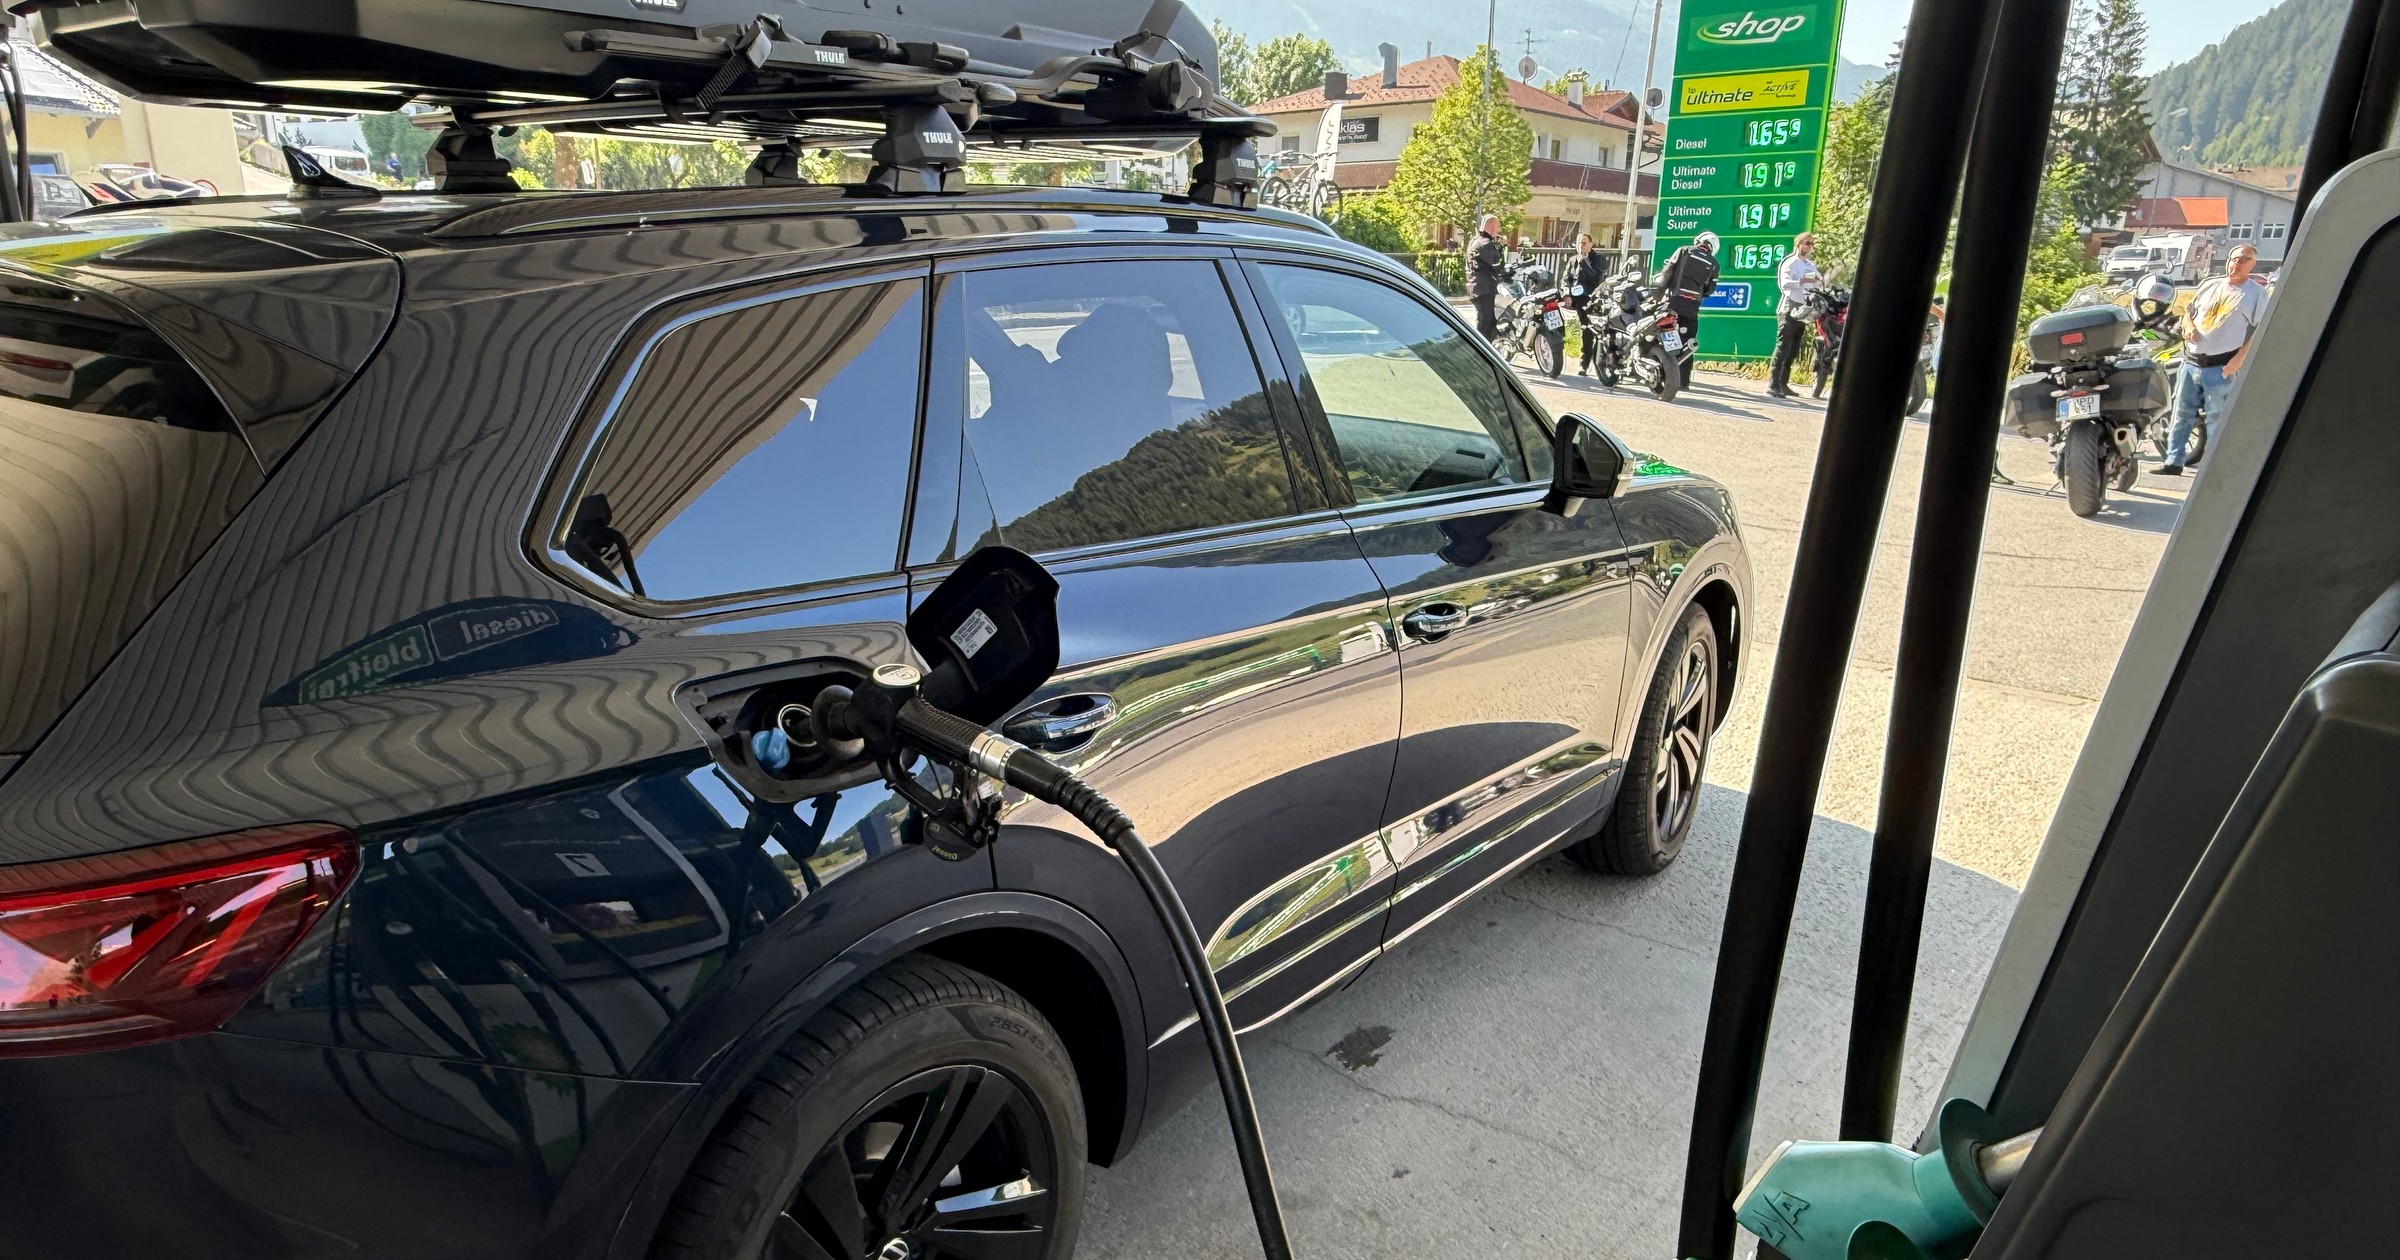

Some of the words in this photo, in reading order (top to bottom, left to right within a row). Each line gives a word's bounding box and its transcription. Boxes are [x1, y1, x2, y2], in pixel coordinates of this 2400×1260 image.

[1718, 12, 1805, 42] shop
[815, 50, 845, 63] THULE
[1686, 88, 1753, 105] ultimate
[923, 131, 953, 143] THULE
[1676, 138, 1707, 150] Diesel
[1672, 166, 1716, 177] Ultimate
[1671, 179, 1703, 190] Diesel
[1668, 206, 1712, 217] Ultimate
[1666, 219, 1698, 231] Super
